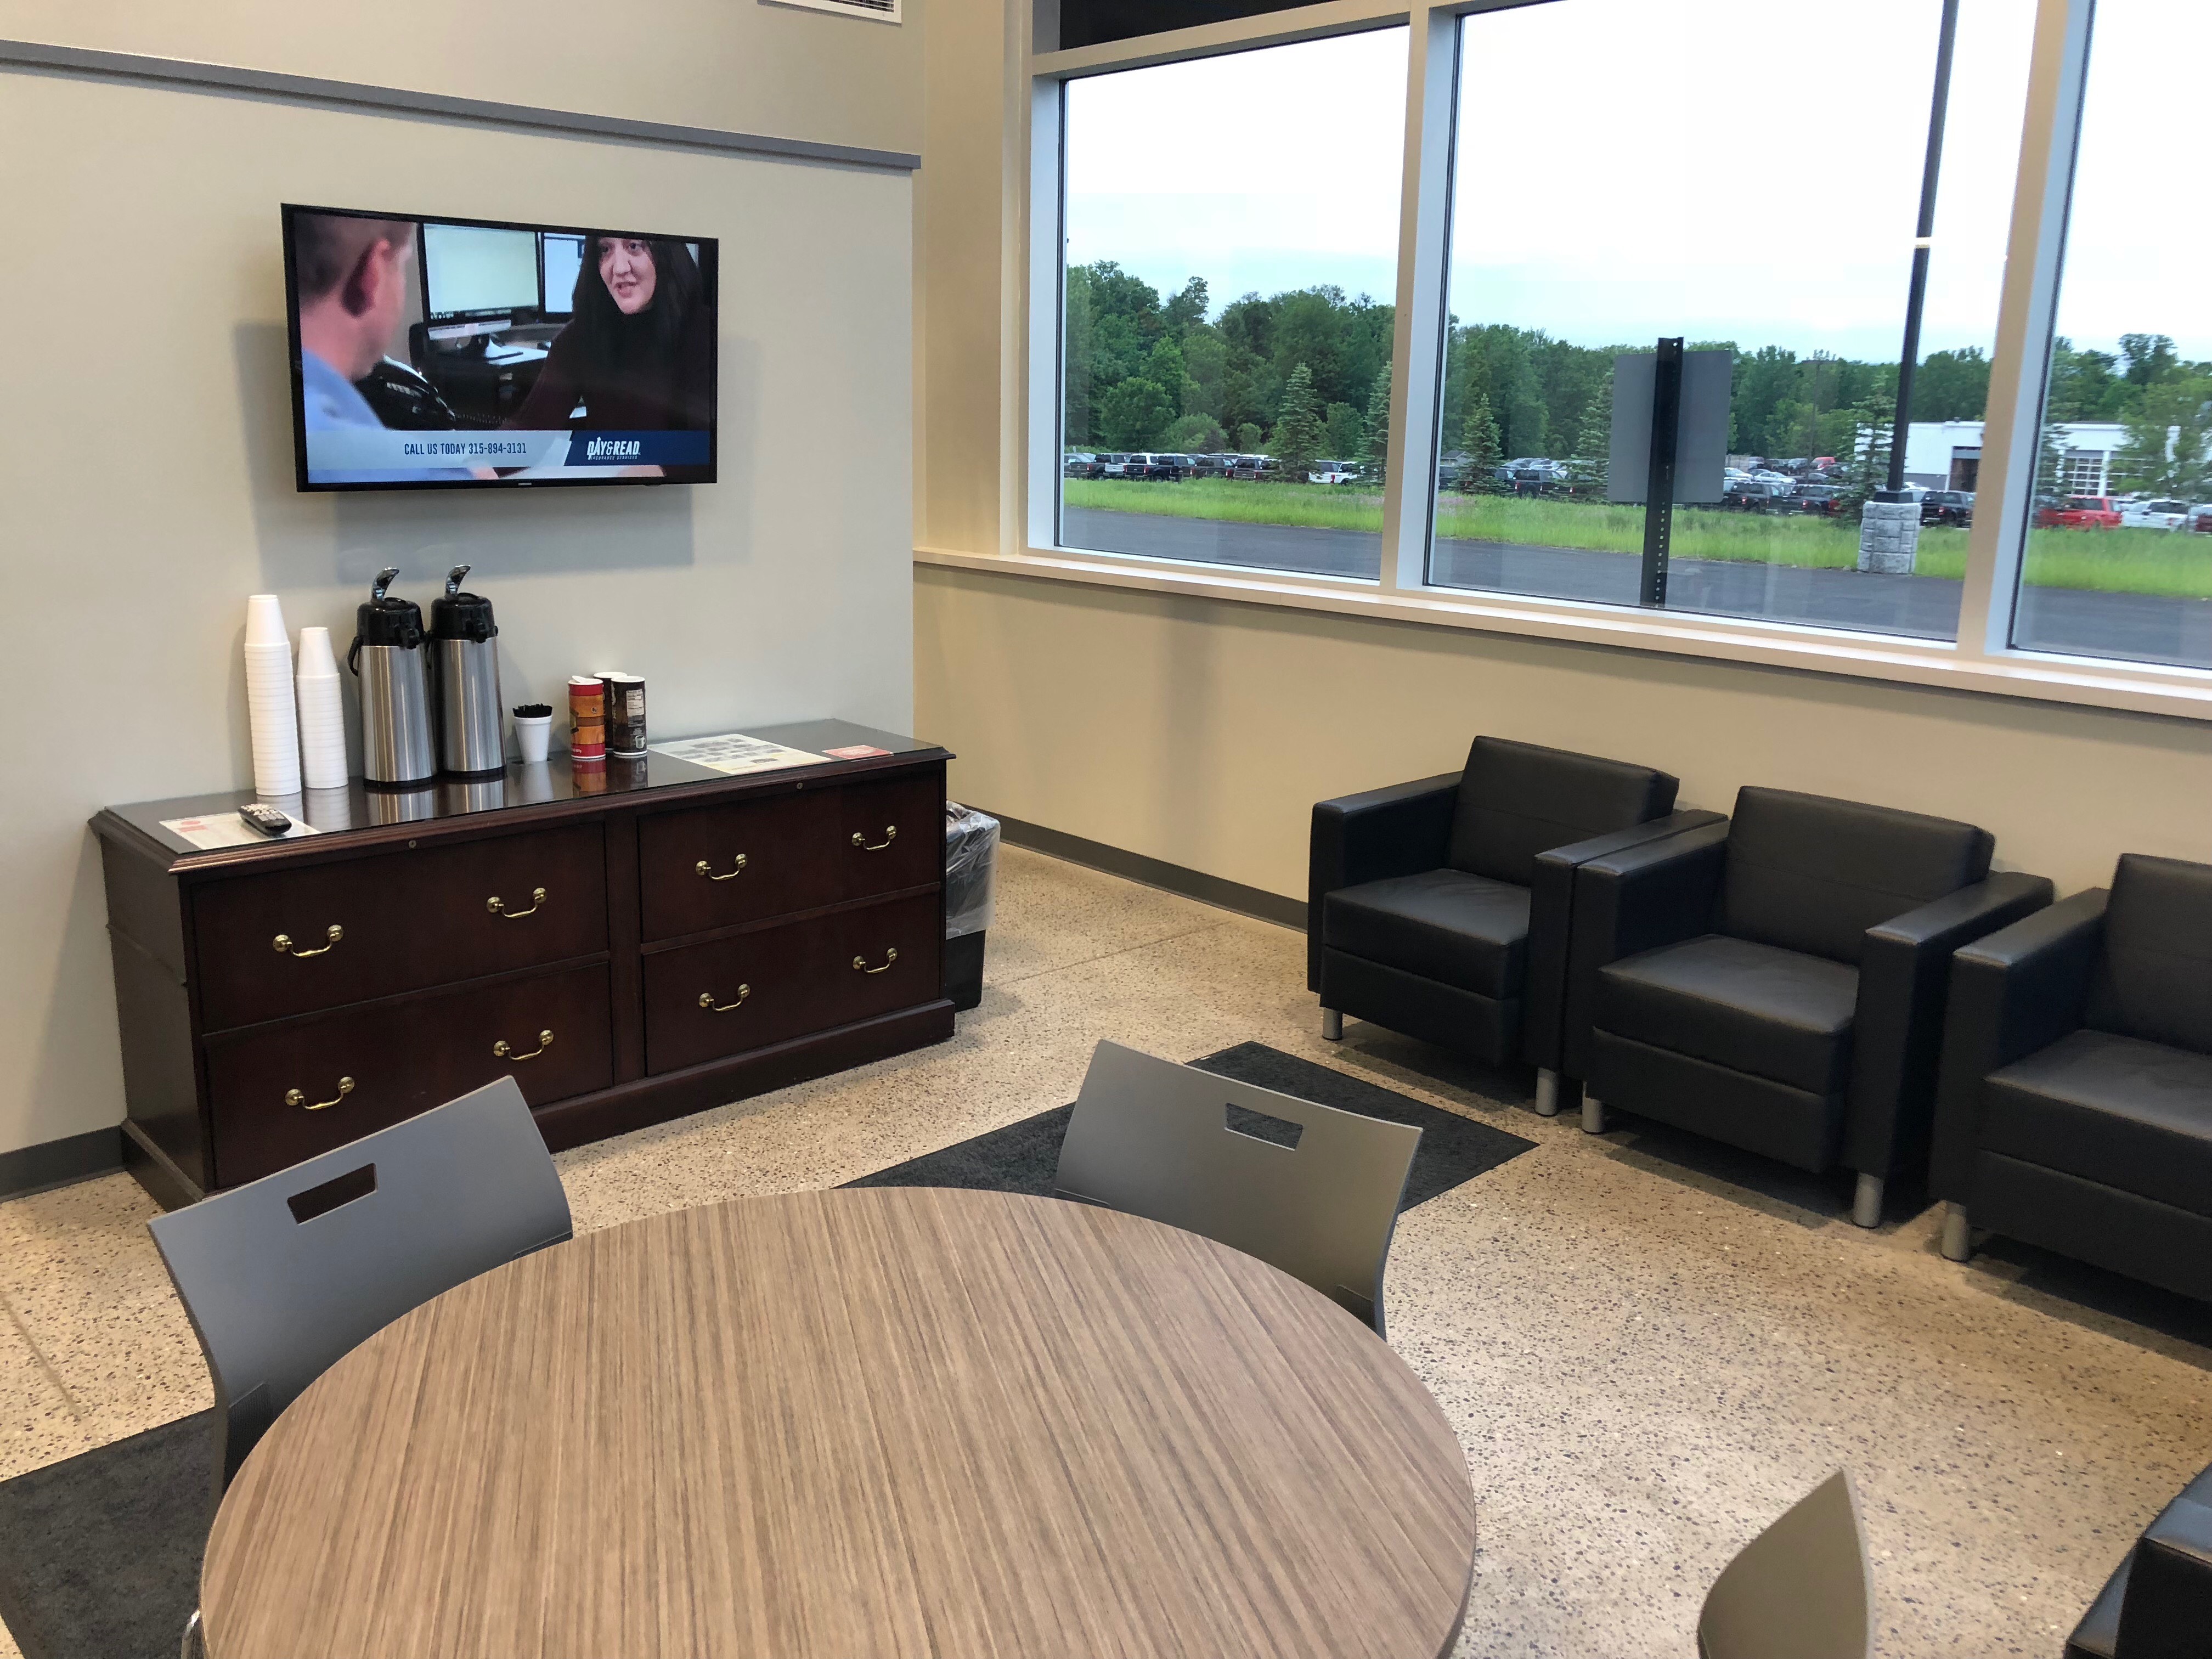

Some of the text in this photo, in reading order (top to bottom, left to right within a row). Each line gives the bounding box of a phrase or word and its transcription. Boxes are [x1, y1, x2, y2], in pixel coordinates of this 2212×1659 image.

[404, 443, 527, 455] CALL US TODAY 315-894-3131
